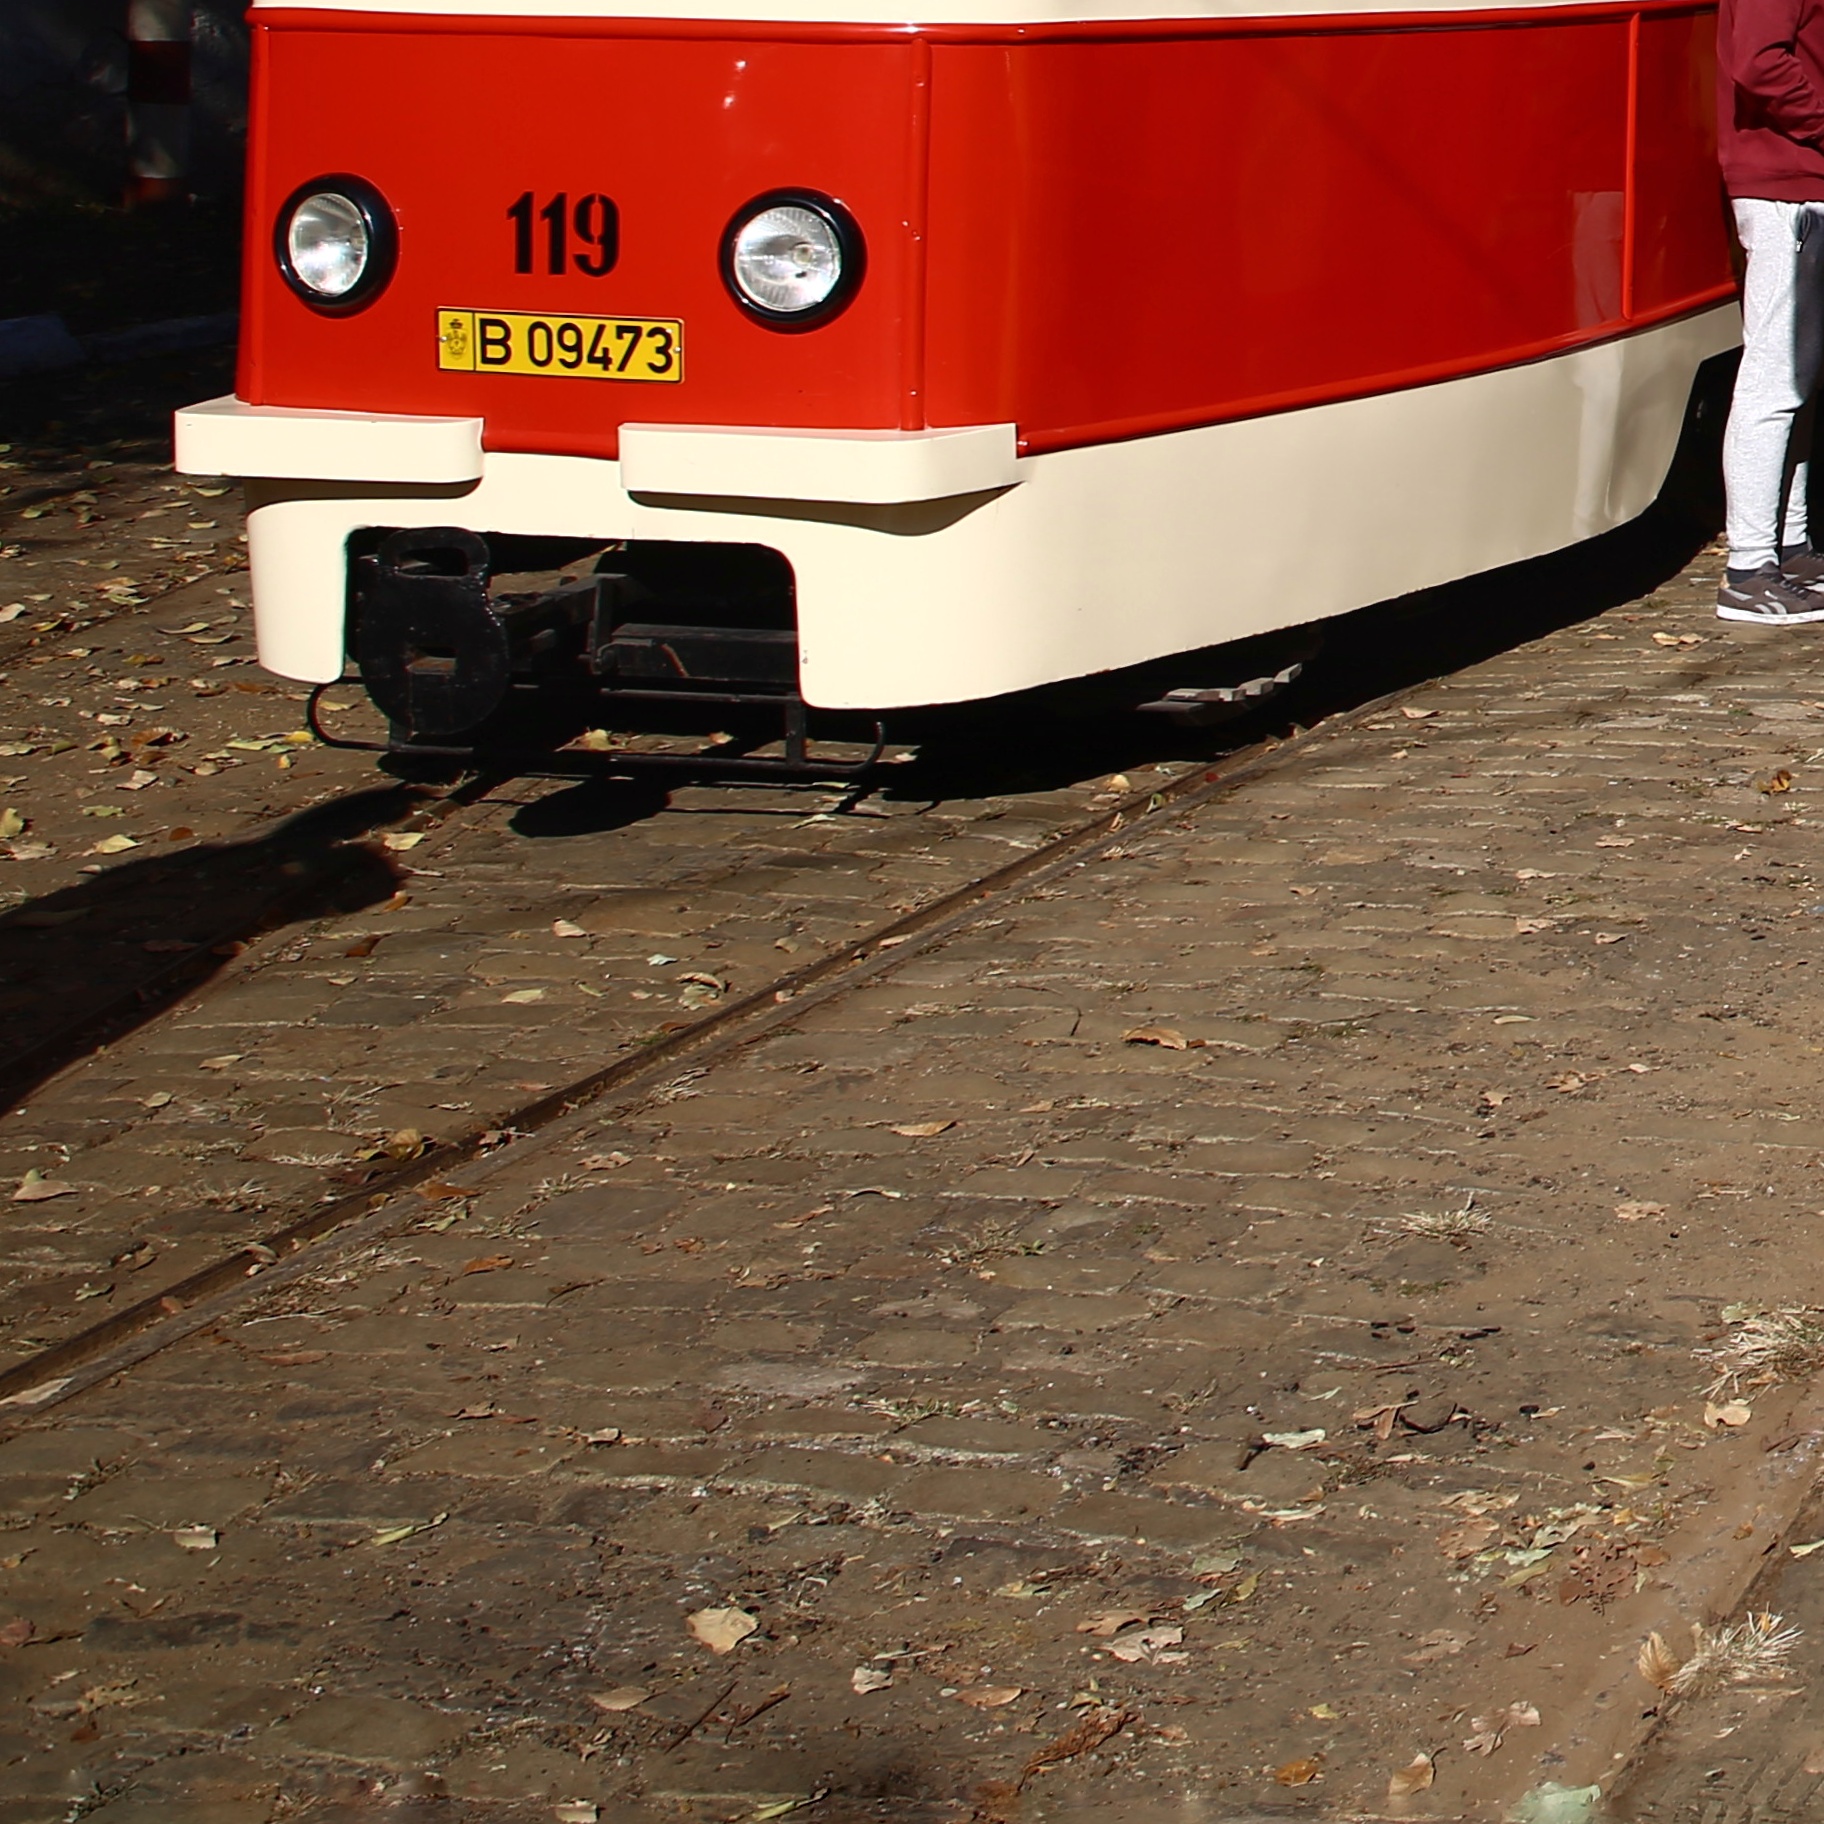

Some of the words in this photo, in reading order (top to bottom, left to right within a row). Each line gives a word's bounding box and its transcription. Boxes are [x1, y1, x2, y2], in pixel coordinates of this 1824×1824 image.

[506, 191, 620, 278] 119
[479, 318, 513, 366] B
[526, 320, 675, 375] 09473
